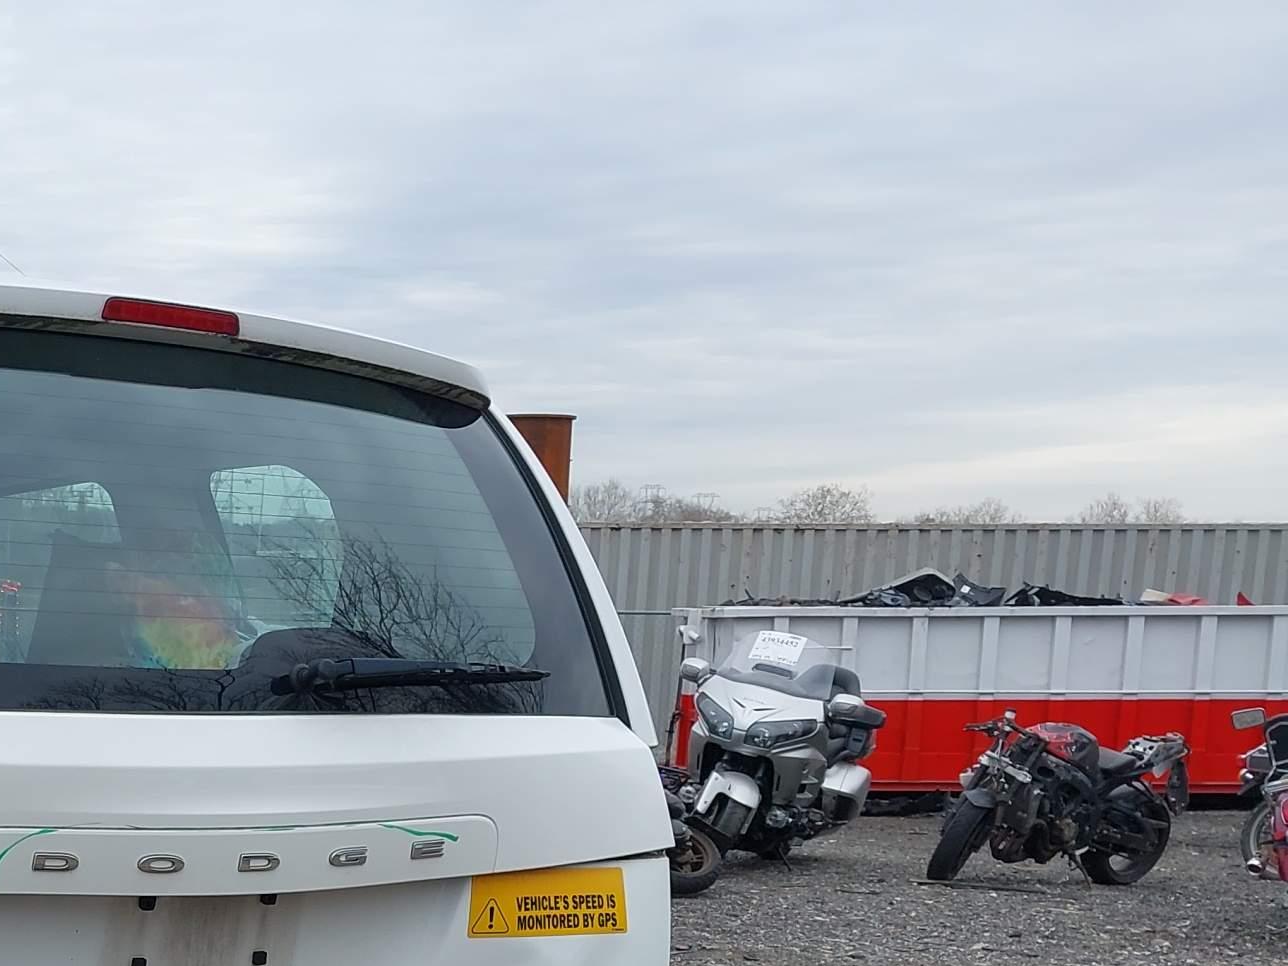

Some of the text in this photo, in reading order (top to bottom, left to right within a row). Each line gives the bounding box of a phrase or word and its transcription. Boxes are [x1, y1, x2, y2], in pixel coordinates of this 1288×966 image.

[31, 839, 446, 874] DODGE
[516, 894, 616, 912] VEHICLE'S SPEED IS
[517, 912, 617, 931] MONITORED BY GPS
